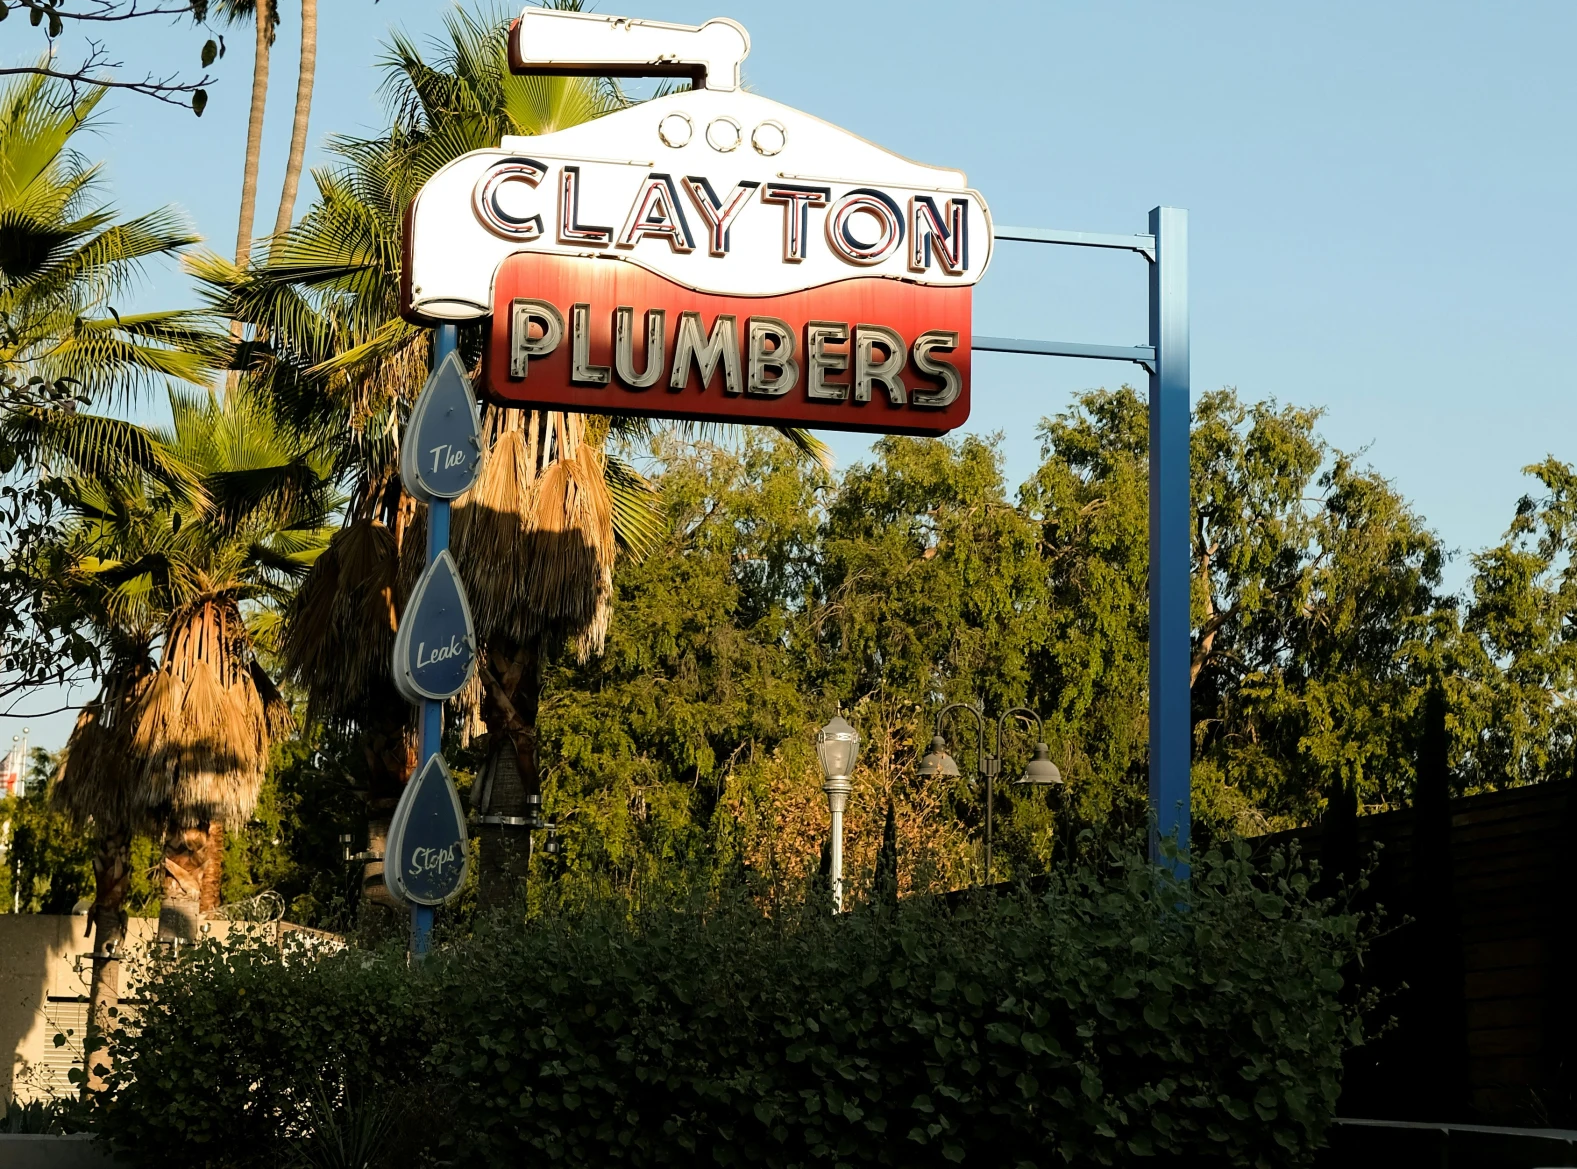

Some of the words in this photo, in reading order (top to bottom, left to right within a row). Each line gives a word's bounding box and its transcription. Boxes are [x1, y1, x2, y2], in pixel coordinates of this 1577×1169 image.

[471, 158, 969, 274] CLAYTON
[510, 298, 963, 407] PLUMBERS
[429, 443, 466, 474] The
[416, 635, 463, 670] Leak
[408, 846, 456, 876] Stops
